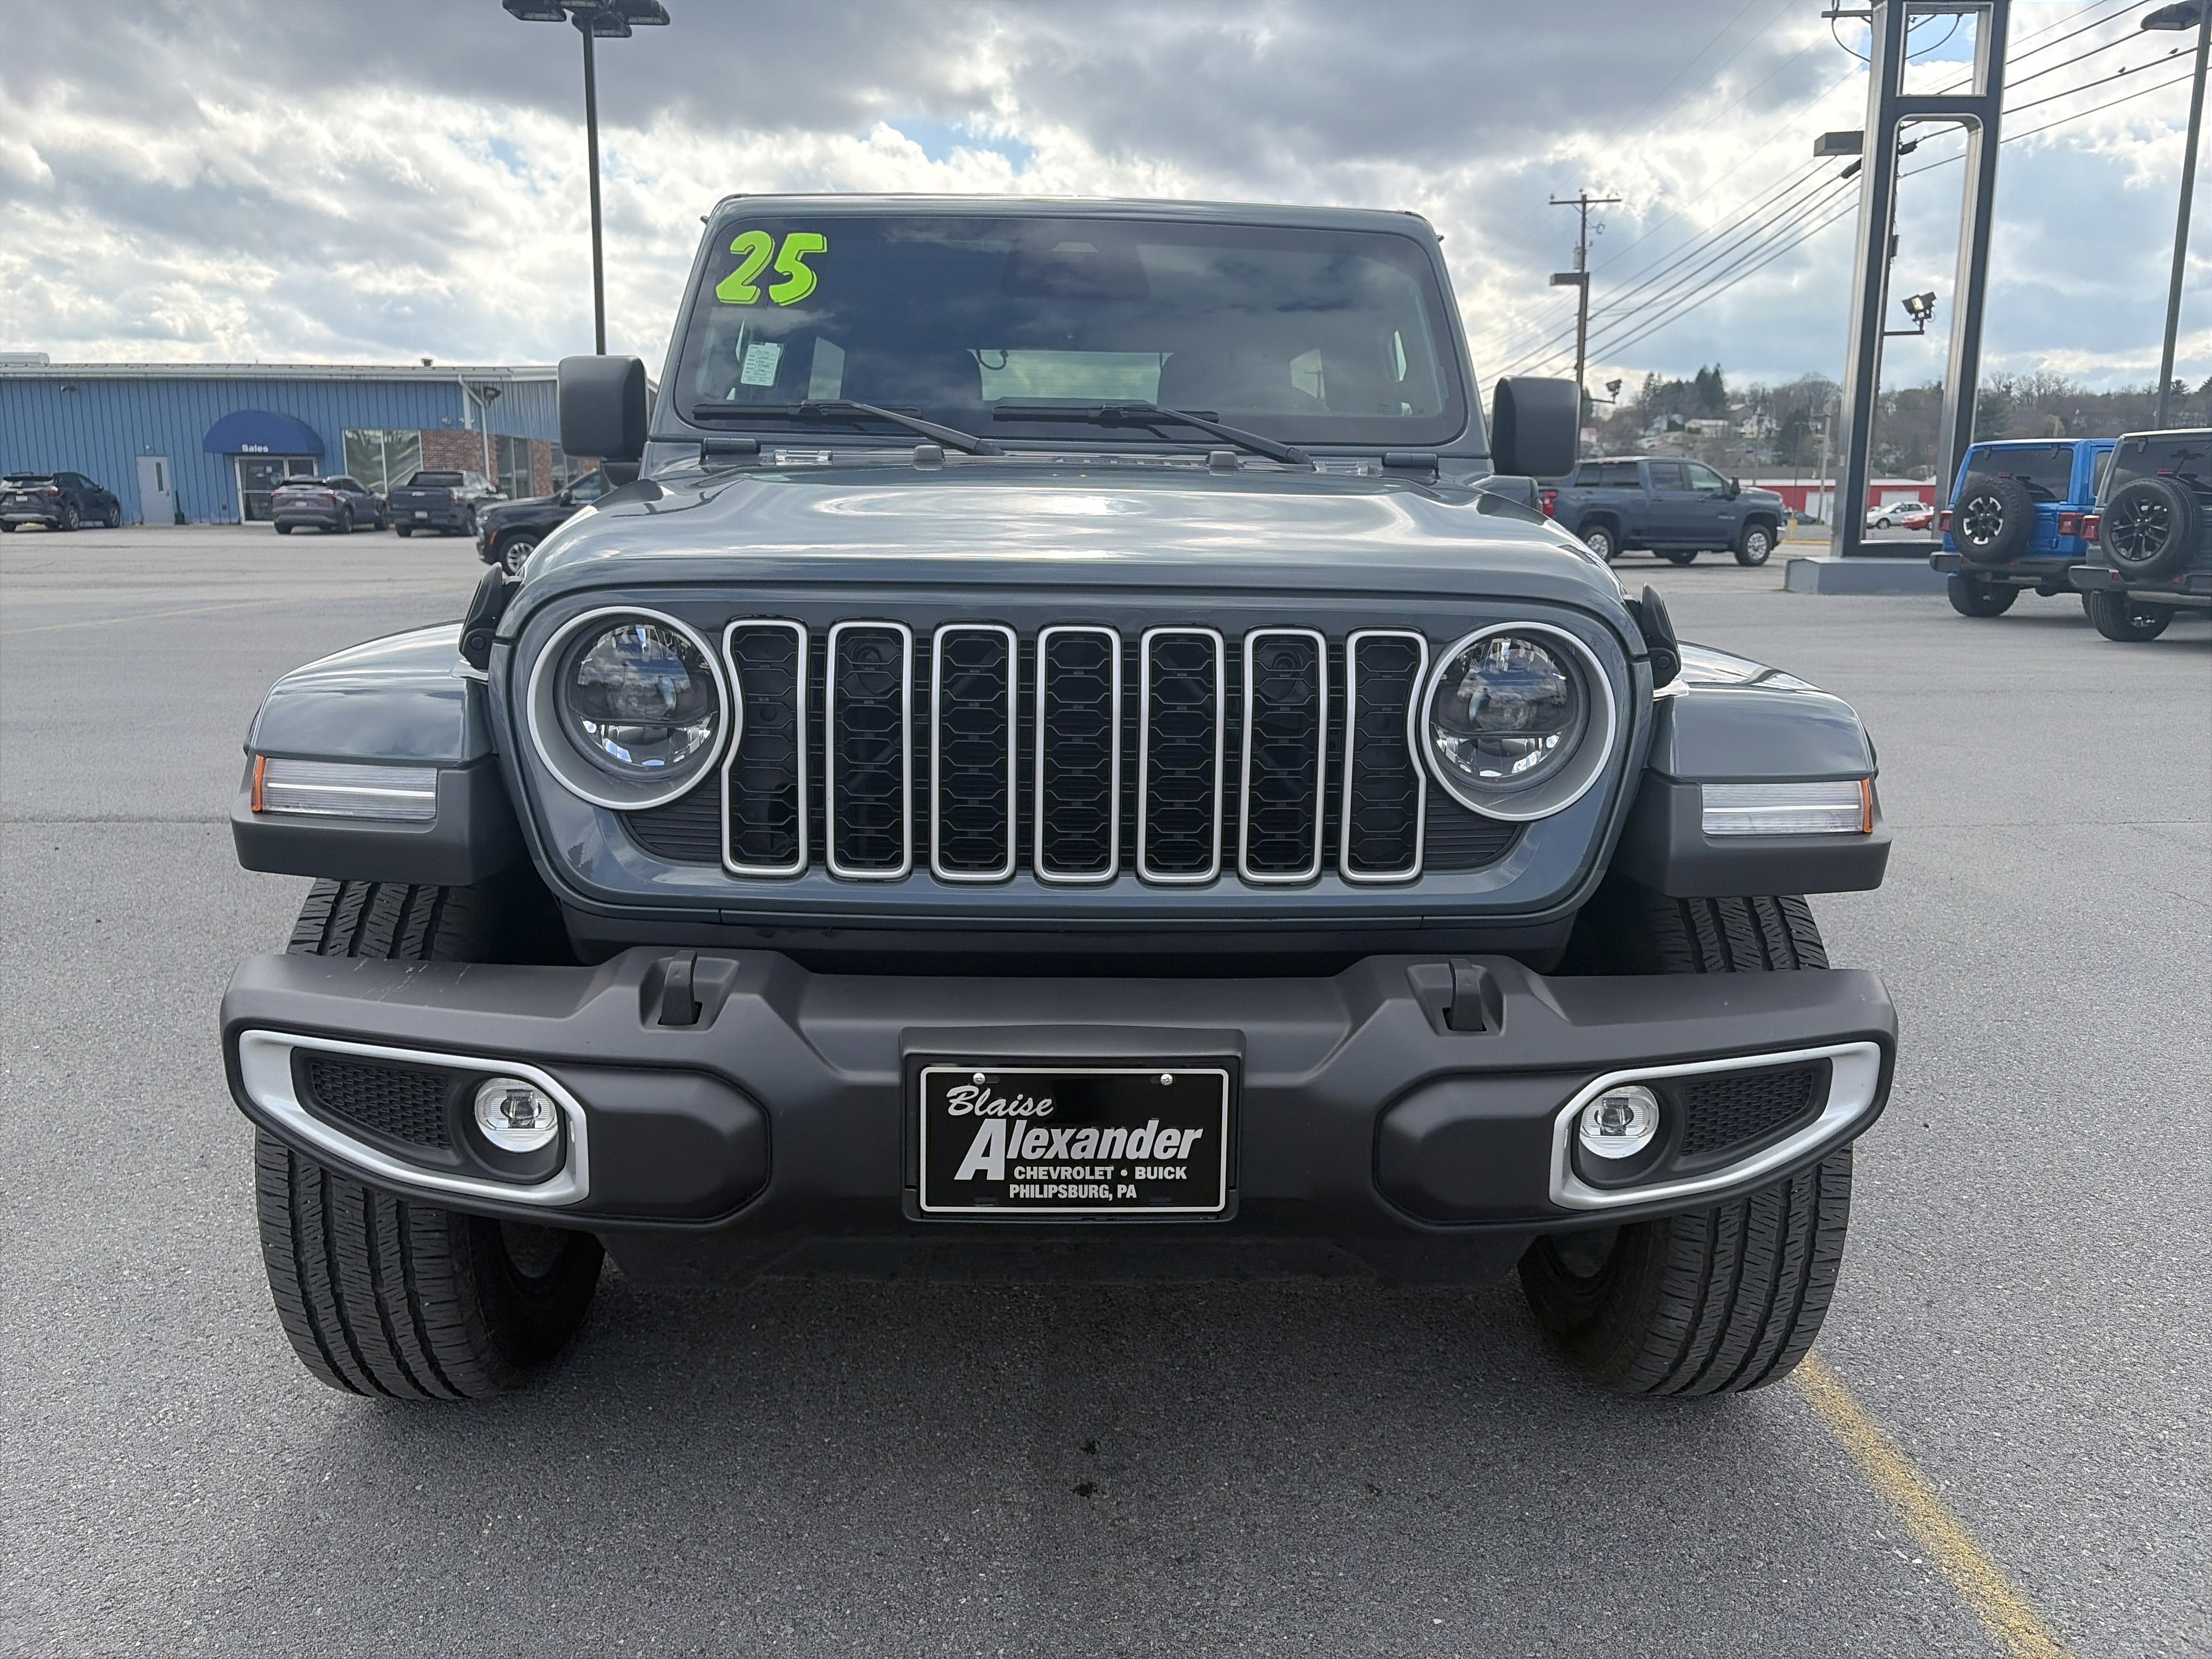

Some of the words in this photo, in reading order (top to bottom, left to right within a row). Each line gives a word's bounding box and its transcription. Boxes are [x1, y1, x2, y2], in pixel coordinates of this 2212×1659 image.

[715, 230, 827, 306] 25
[242, 444, 268, 453] Sales
[946, 1085, 1054, 1116] Blaise
[953, 1119, 1204, 1181] Alexander
[1014, 1166, 1114, 1180] CHEVROLET
[1135, 1166, 1187, 1180] BUICK
[1009, 1184, 1113, 1201] PHILIPSBURG,
[1117, 1184, 1137, 1198] PA
